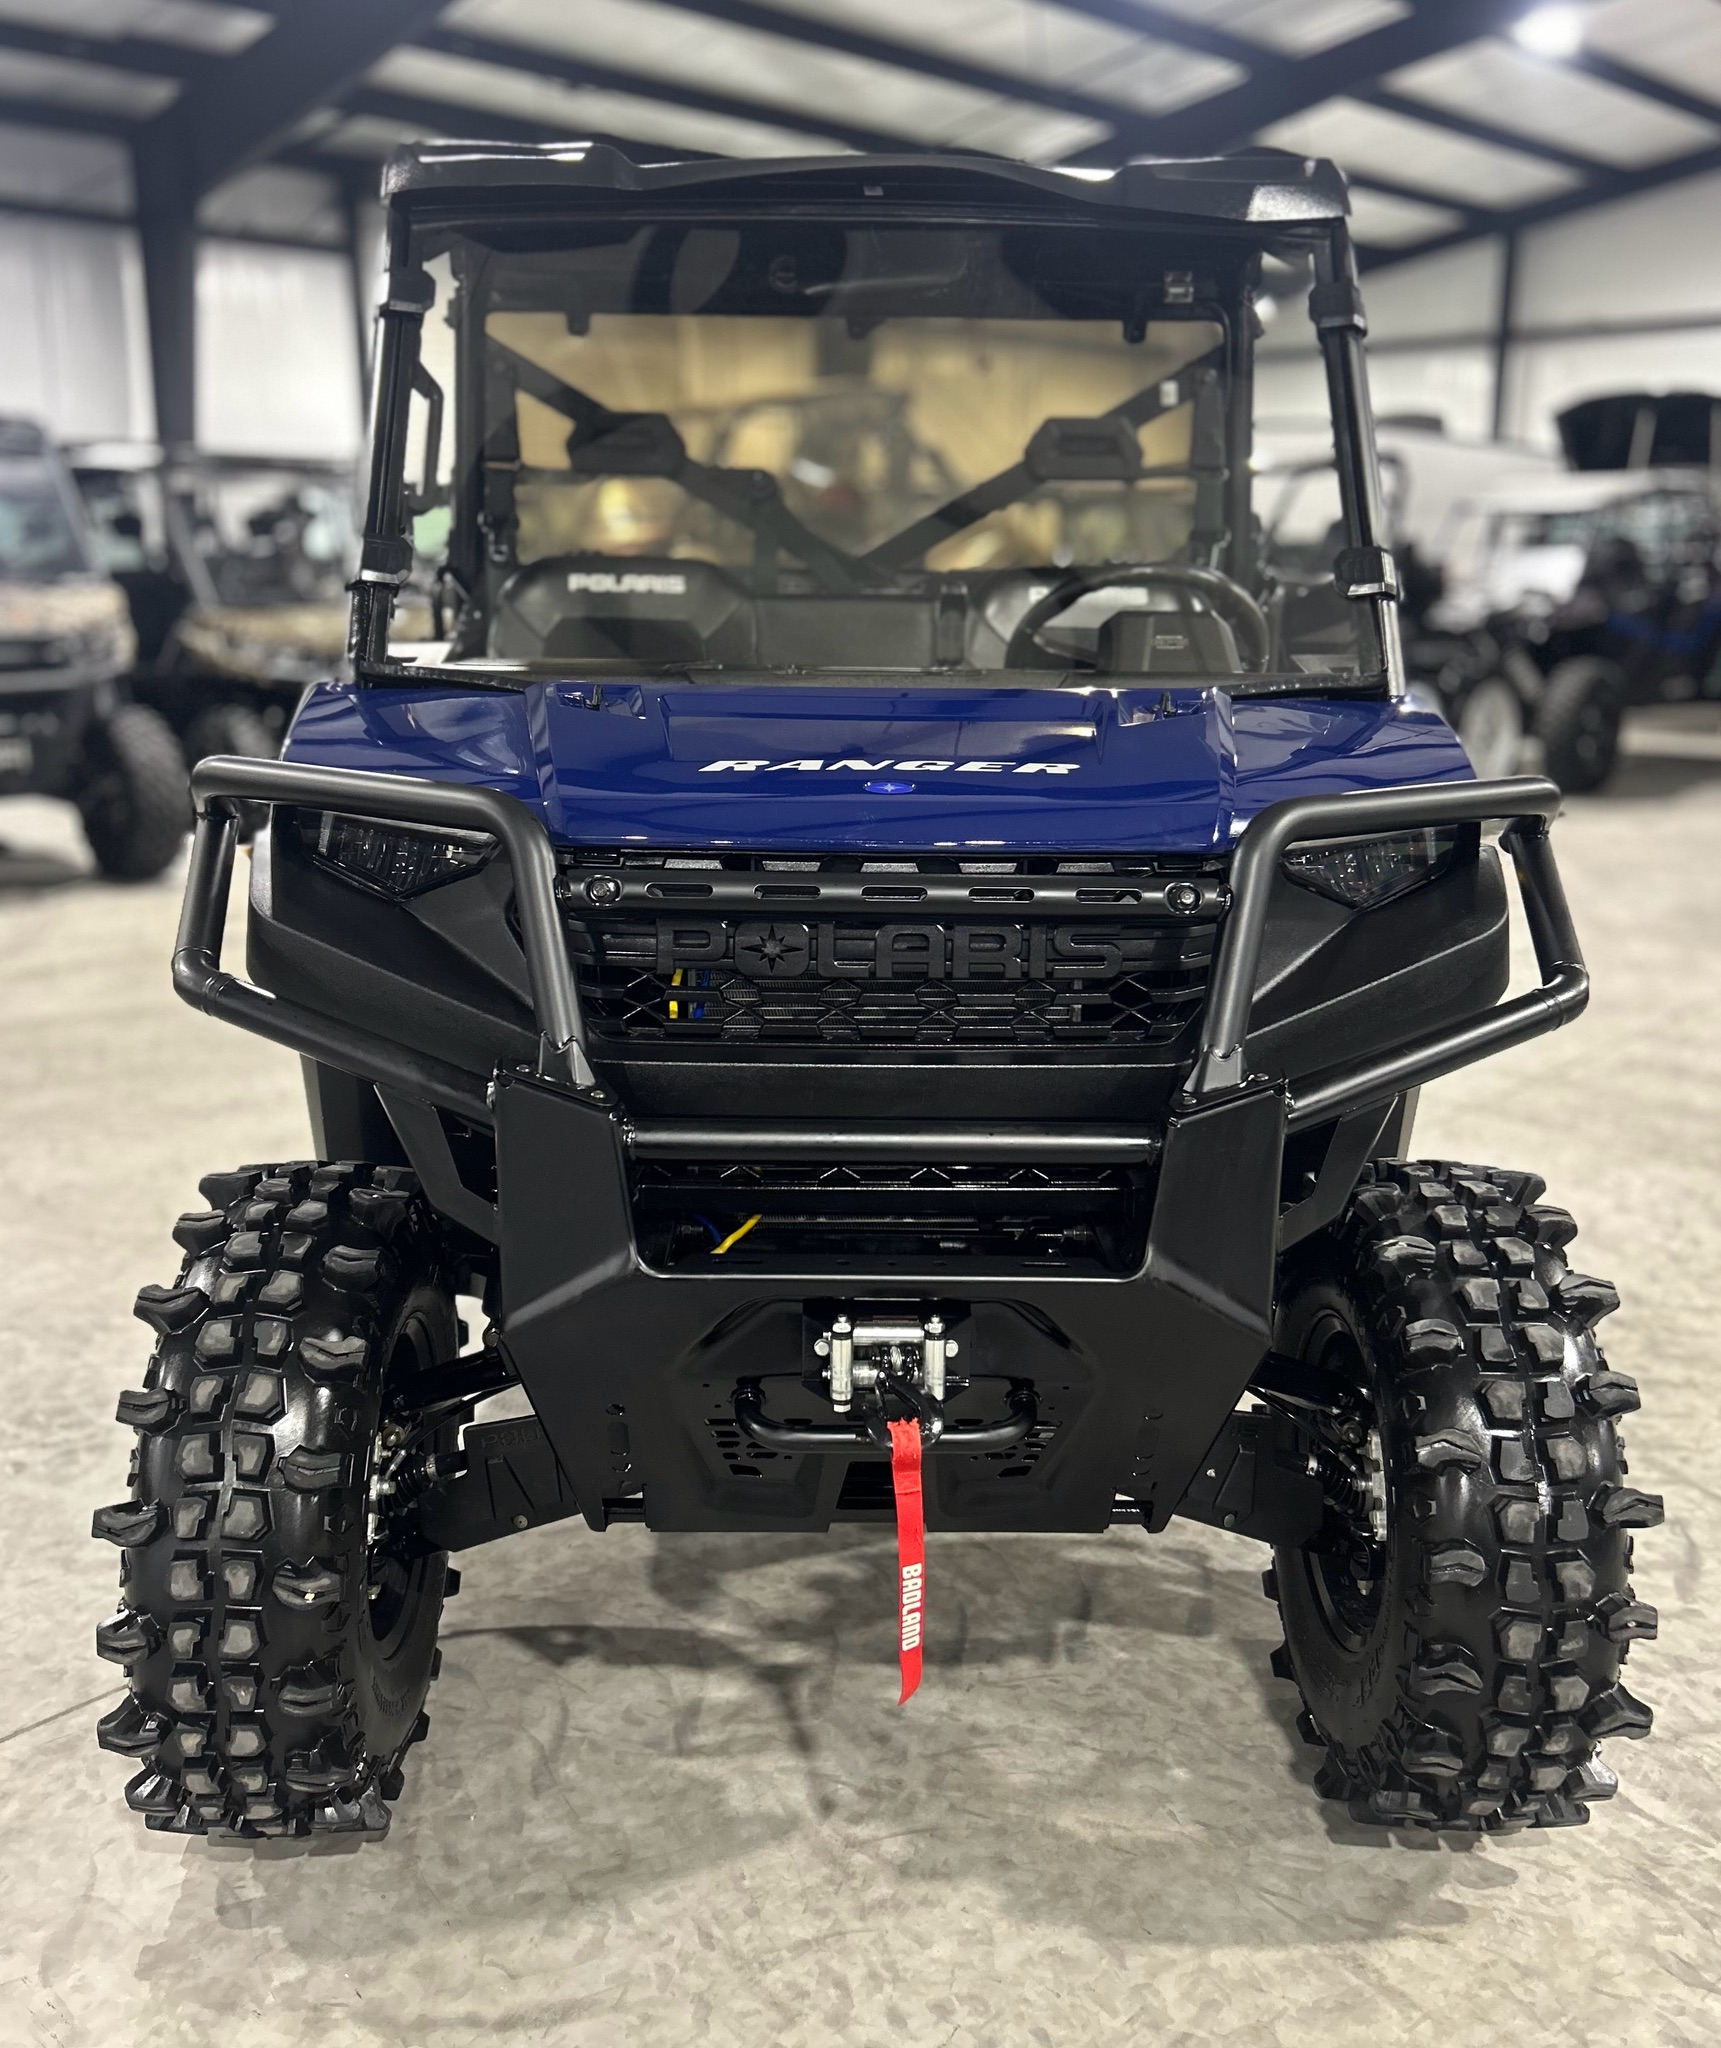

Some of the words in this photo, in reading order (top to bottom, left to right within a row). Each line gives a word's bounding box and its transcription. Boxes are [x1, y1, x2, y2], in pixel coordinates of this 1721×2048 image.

[567, 573, 686, 594] POLARIS
[698, 759, 1081, 775] RANGER
[655, 918, 1123, 979] POLARIS
[902, 1563, 922, 1652] BADLAND
